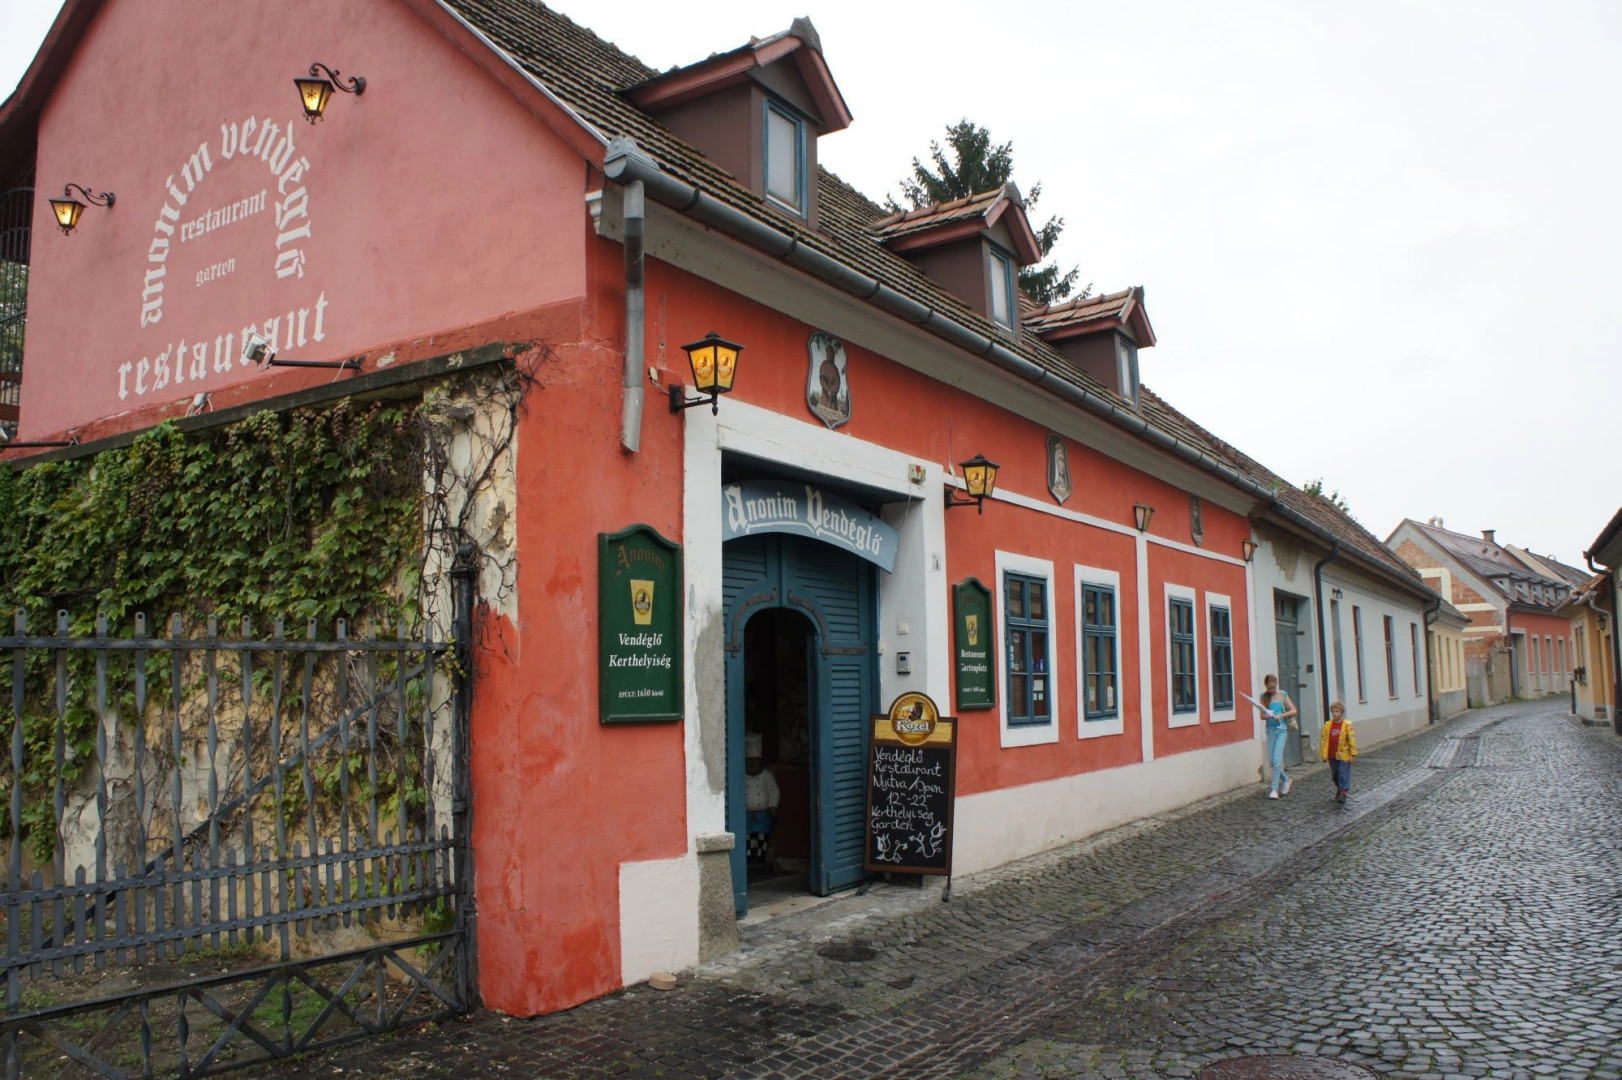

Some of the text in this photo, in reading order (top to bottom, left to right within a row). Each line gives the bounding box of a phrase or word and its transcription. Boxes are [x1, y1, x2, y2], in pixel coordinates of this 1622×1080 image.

[180, 188, 268, 242] restaurant
[141, 141, 213, 328] anonim
[196, 257, 235, 287] garten
[118, 290, 329, 401] restaurant
[725, 485, 883, 556] Anonim Vendéglő
[618, 633, 663, 648] Vendéglő
[609, 653, 672, 669] Kerthelyiség
[896, 720, 930, 733] Kozel
[873, 760, 942, 777] Restaurant
[871, 817, 915, 834] Garden
